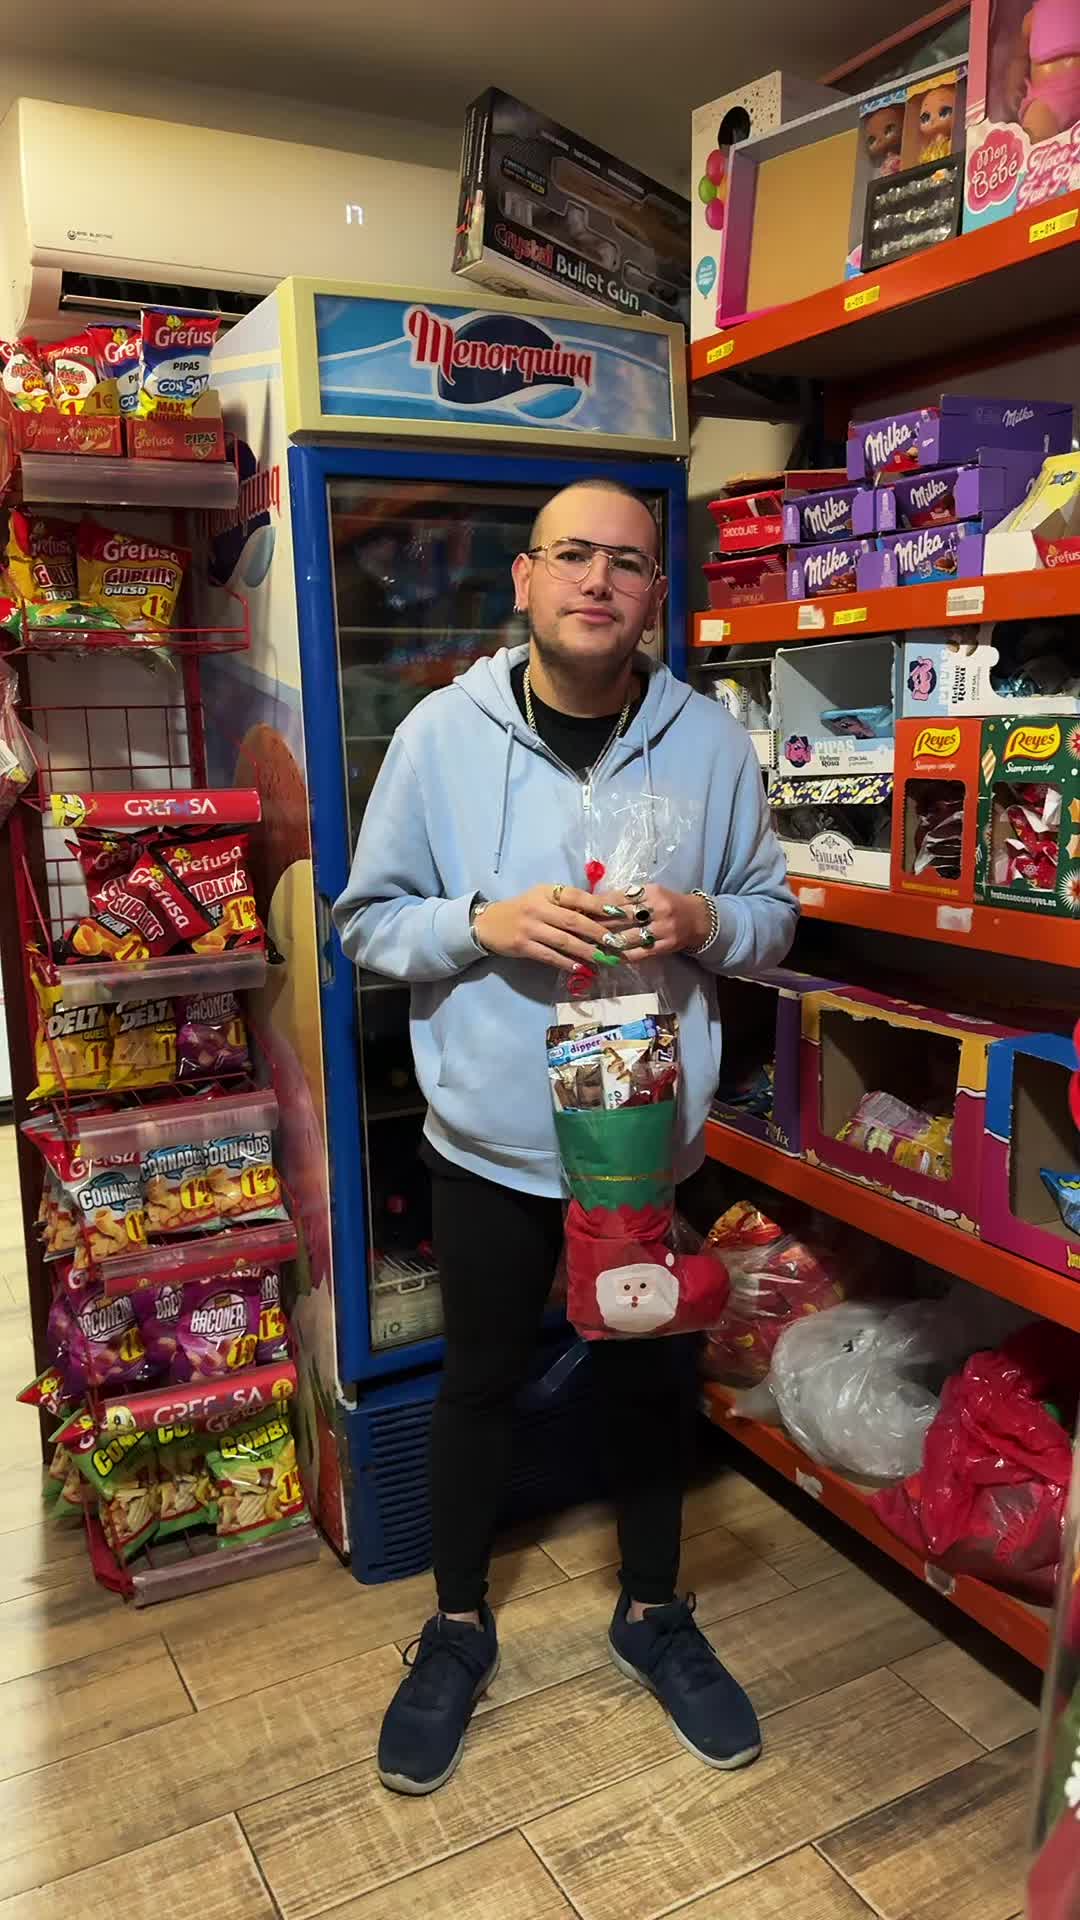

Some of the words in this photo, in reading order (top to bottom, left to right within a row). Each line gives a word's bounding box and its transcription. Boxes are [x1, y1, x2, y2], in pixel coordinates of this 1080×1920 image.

[976, 144, 1008, 170] Mon
[971, 151, 1018, 199] Bébé
[556, 252, 605, 294] Bullet
[607, 281, 640, 311] Gun
[104, 338, 142, 363] Gref
[408, 309, 593, 388] Menorquina
[172, 361, 200, 371] PIPAS
[158, 380, 185, 393] CON
[119, 395, 139, 408] CO
[1002, 406, 1035, 428] Milka
[184, 432, 217, 444] PIPAS
[865, 421, 912, 466] Milka
[910, 479, 948, 509] Milka
[803, 496, 850, 535] Milka
[721, 524, 760, 538] CHOCOLATE
[103, 539, 179, 562] Grefusa
[893, 530, 945, 575] Milka
[1045, 550, 1080, 568] Grefus
[803, 546, 850, 588] Milka
[104, 585, 147, 596] QUESO
[917, 731, 957, 753] Reyes
[1009, 731, 1056, 753] Reyes
[1005, 761, 1032, 774] Siempre
[1032, 763, 1055, 774] contigo
[168, 845, 243, 878] Grefusa
[128, 867, 190, 929] Grefusa
[187, 869, 249, 906] UBLINS
[83, 1031, 106, 1040] QUES
[570, 1039, 601, 1054] dipper
[603, 1031, 622, 1042] XL
[153, 1386, 263, 1426] GREFSA
